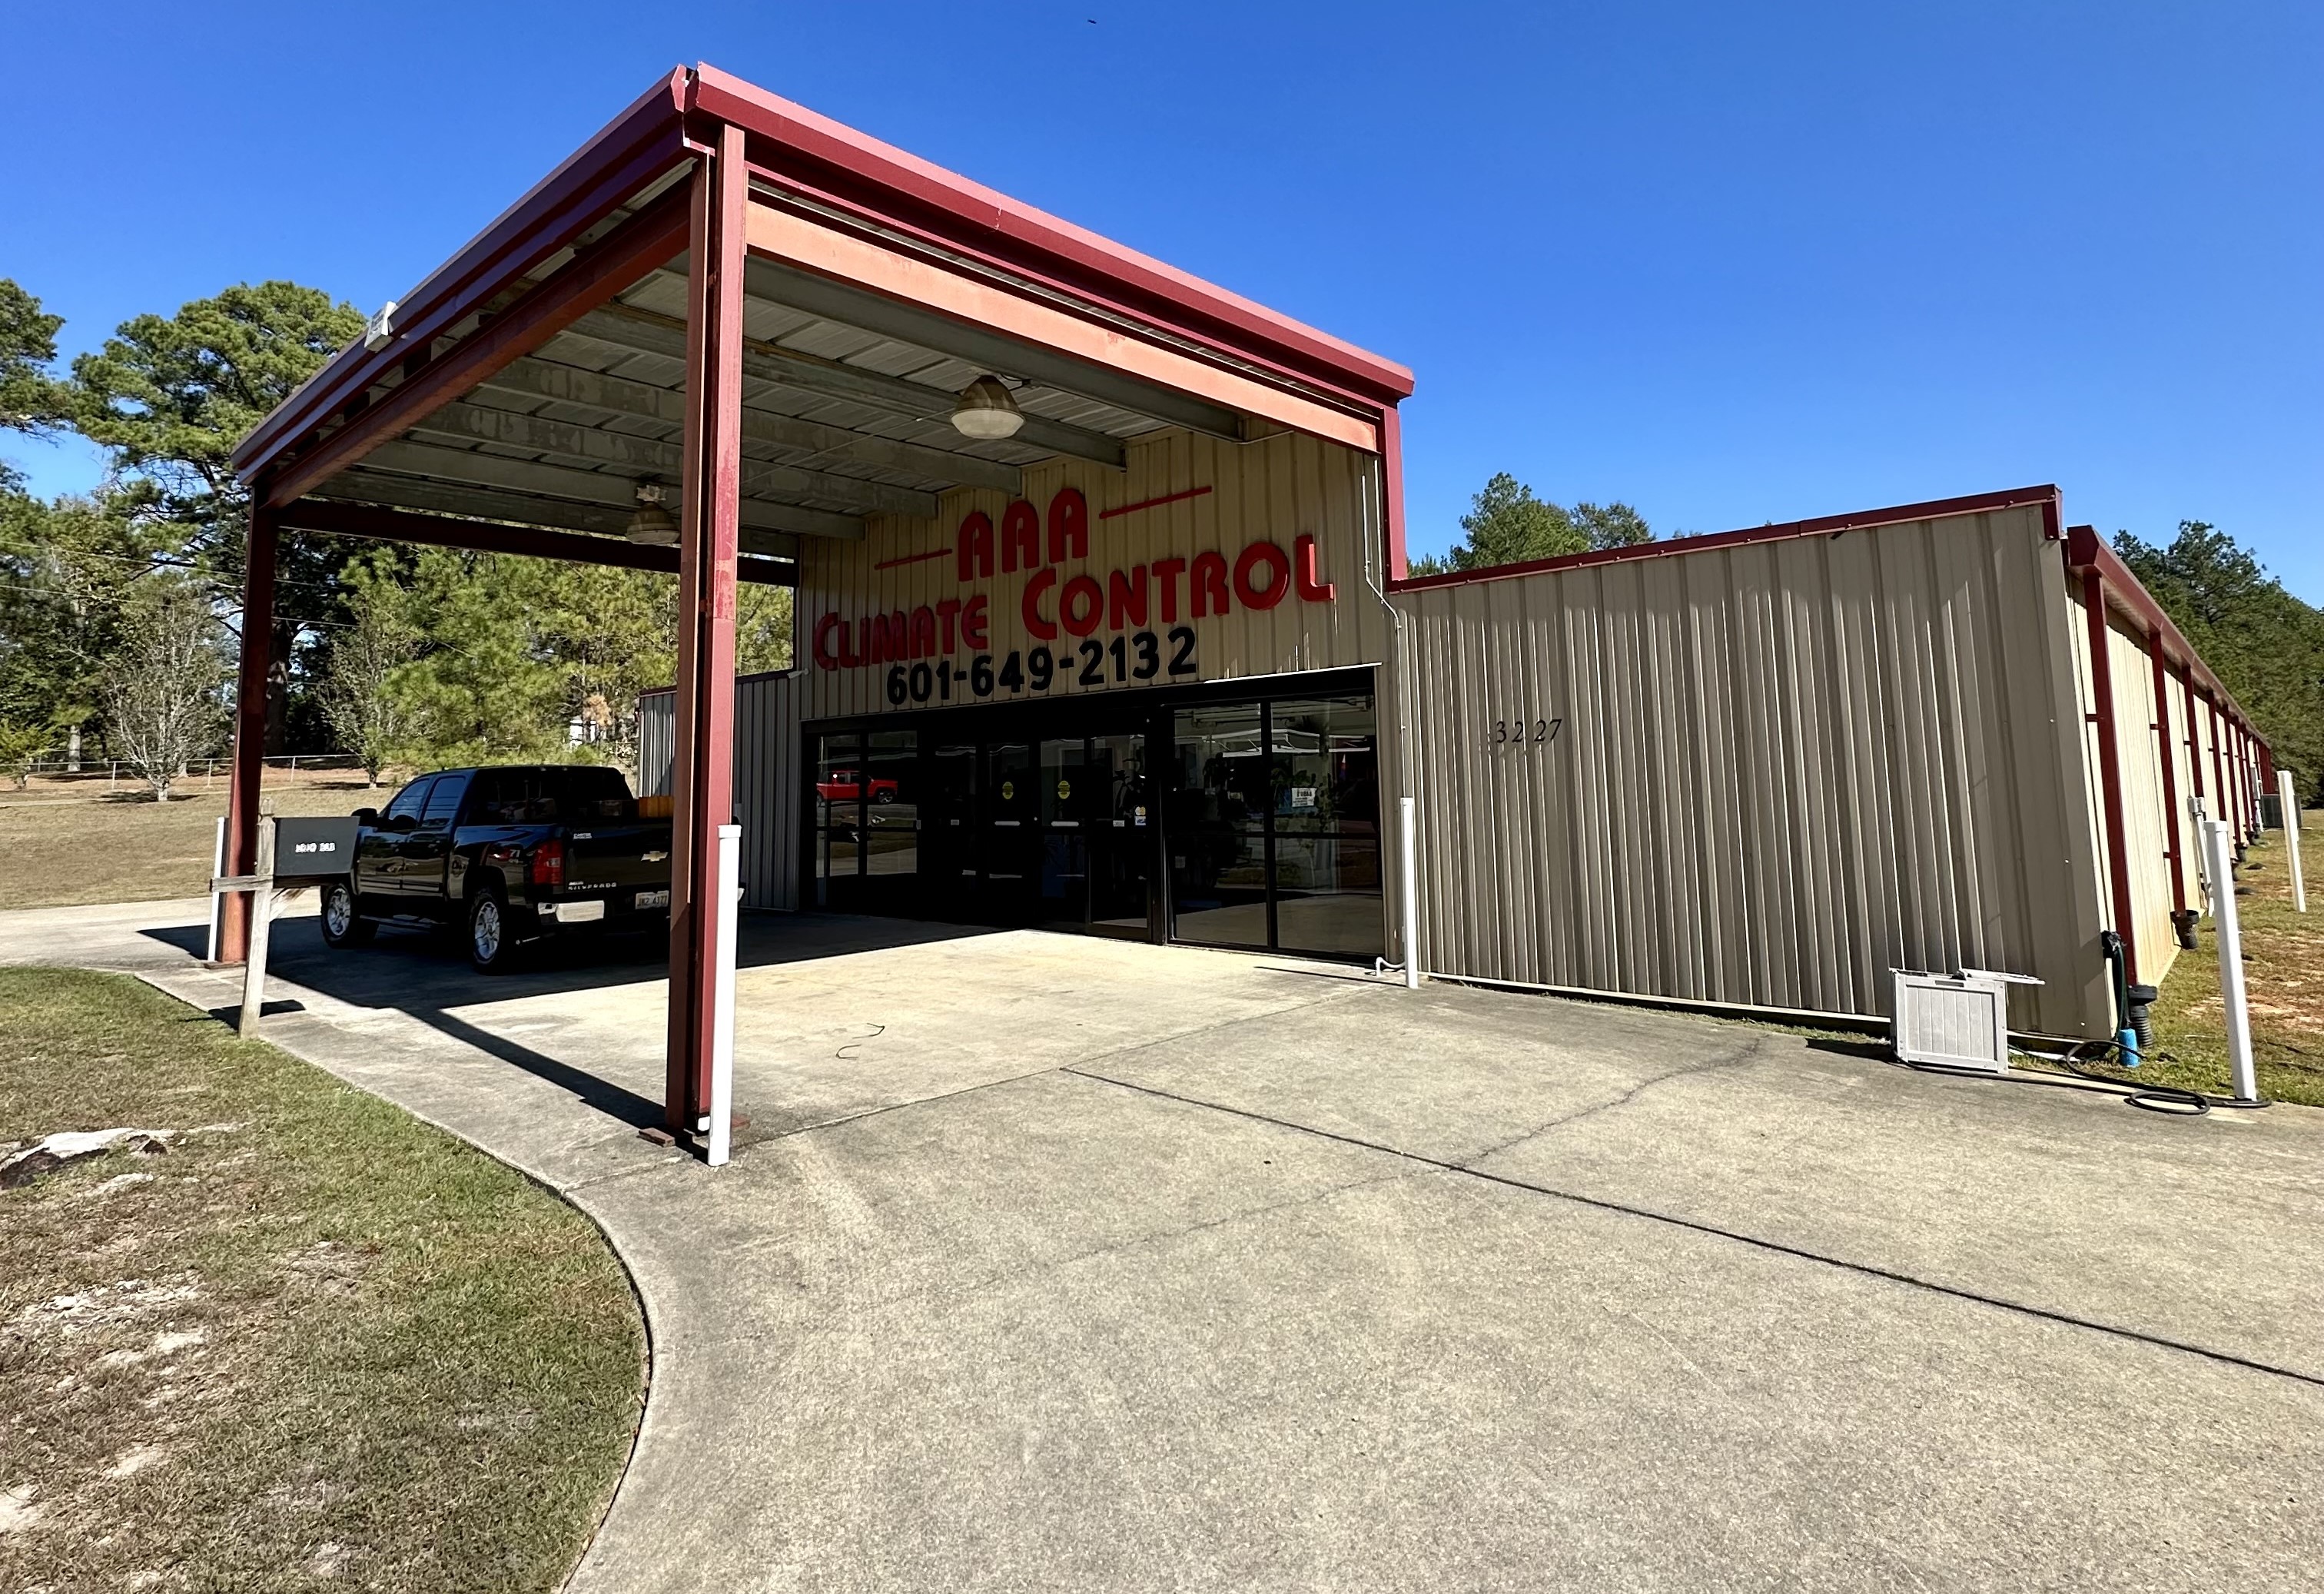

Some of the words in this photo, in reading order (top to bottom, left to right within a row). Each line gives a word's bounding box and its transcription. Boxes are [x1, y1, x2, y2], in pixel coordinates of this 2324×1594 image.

[958, 487, 1088, 582] AAA
[812, 595, 988, 671] CLIMATE
[1021, 534, 1334, 640] CONTROL
[887, 627, 1197, 705] 601-649-2132
[1496, 719, 1562, 743] 3227
